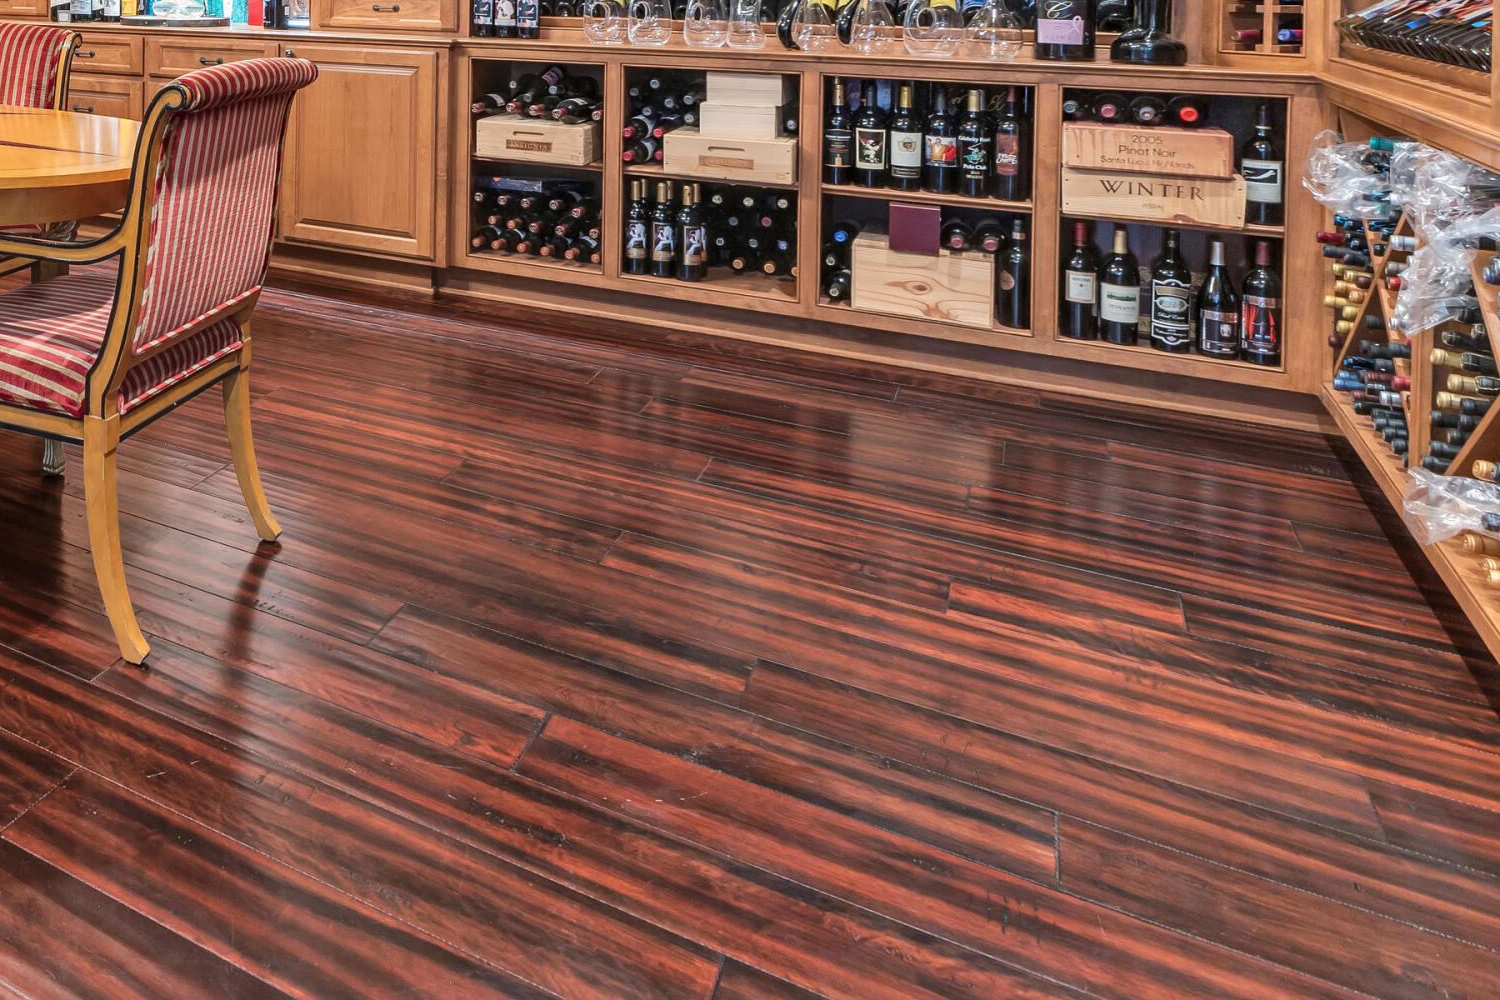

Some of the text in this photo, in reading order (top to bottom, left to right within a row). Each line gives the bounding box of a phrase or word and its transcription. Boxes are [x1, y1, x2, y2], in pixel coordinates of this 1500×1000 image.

[1132, 135, 1164, 144] 2005
[1118, 145, 1178, 157] Pinot Noir
[1100, 156, 1126, 164] Santa
[1100, 180, 1204, 200] WINTER
